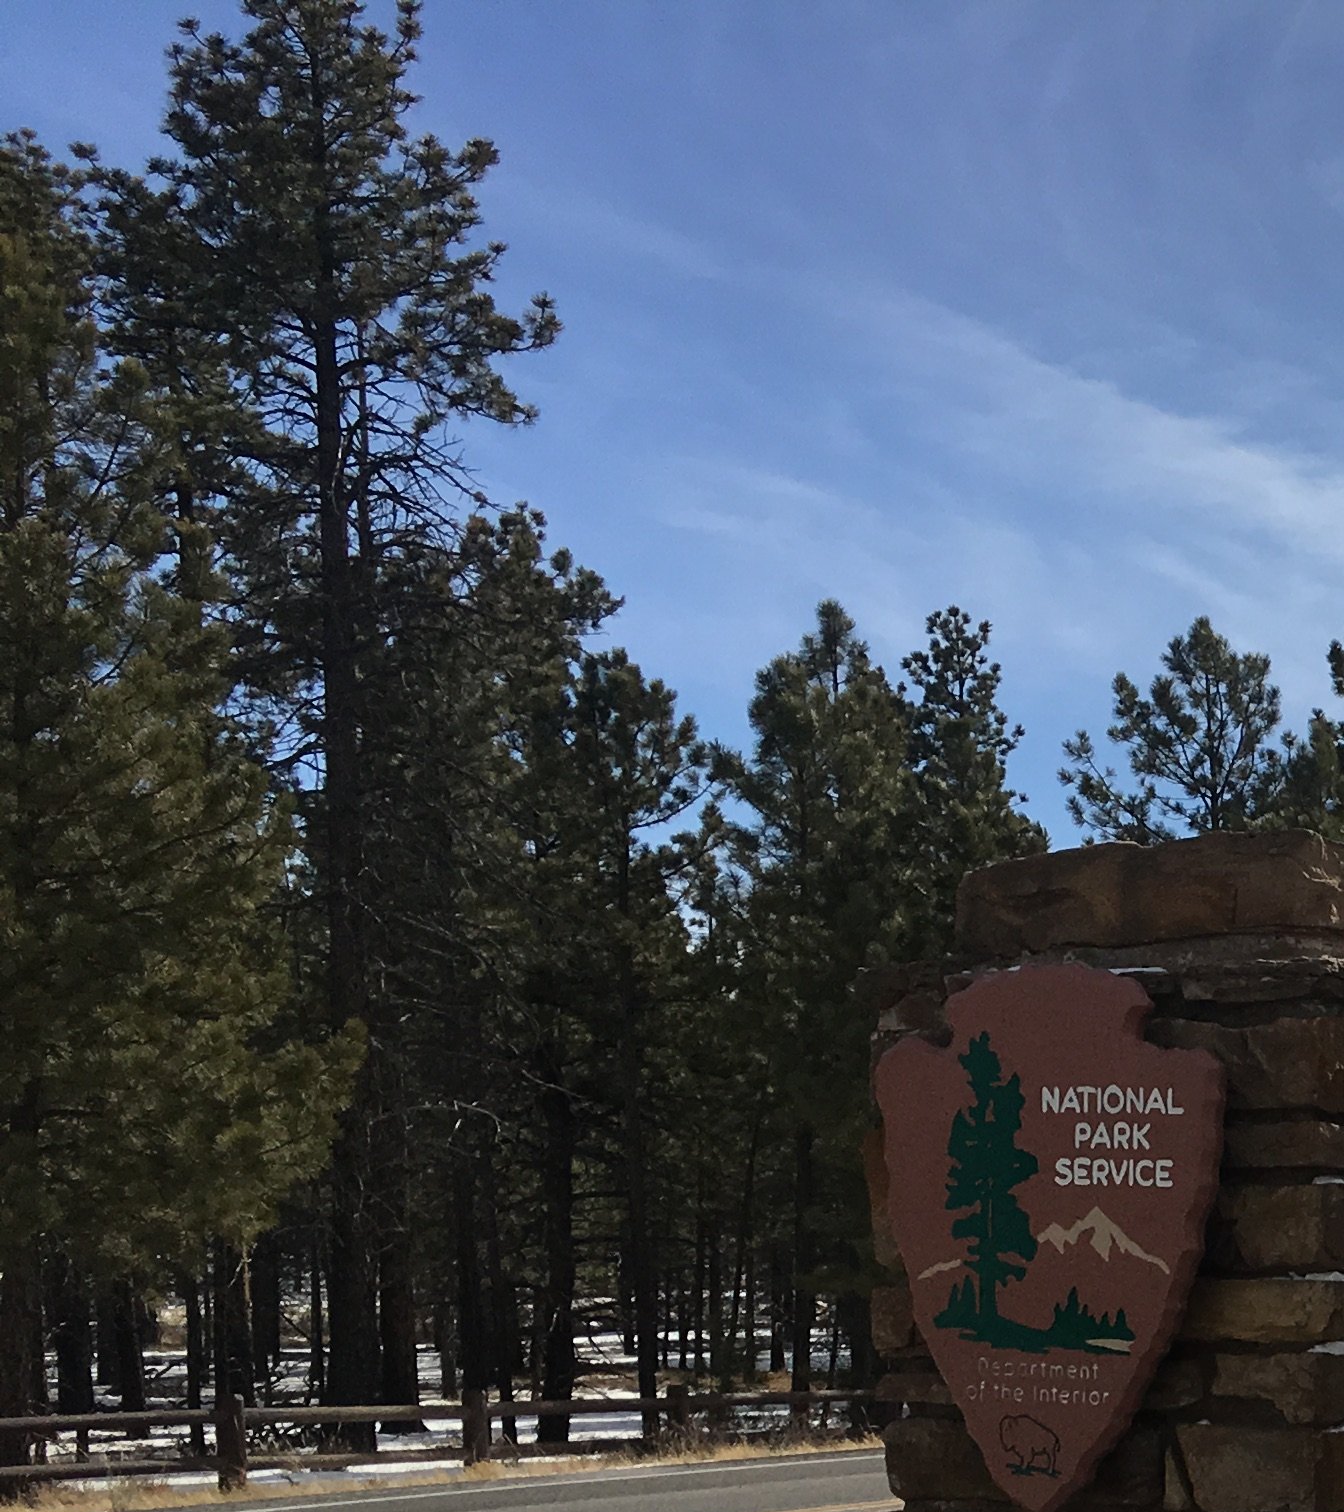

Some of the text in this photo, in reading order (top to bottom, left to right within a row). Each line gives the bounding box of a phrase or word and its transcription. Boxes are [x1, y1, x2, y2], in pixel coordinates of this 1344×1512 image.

[1041, 1085, 1185, 1115] NATIONAL
[1074, 1122, 1151, 1150] PARK
[1054, 1157, 1174, 1188] SERVICE
